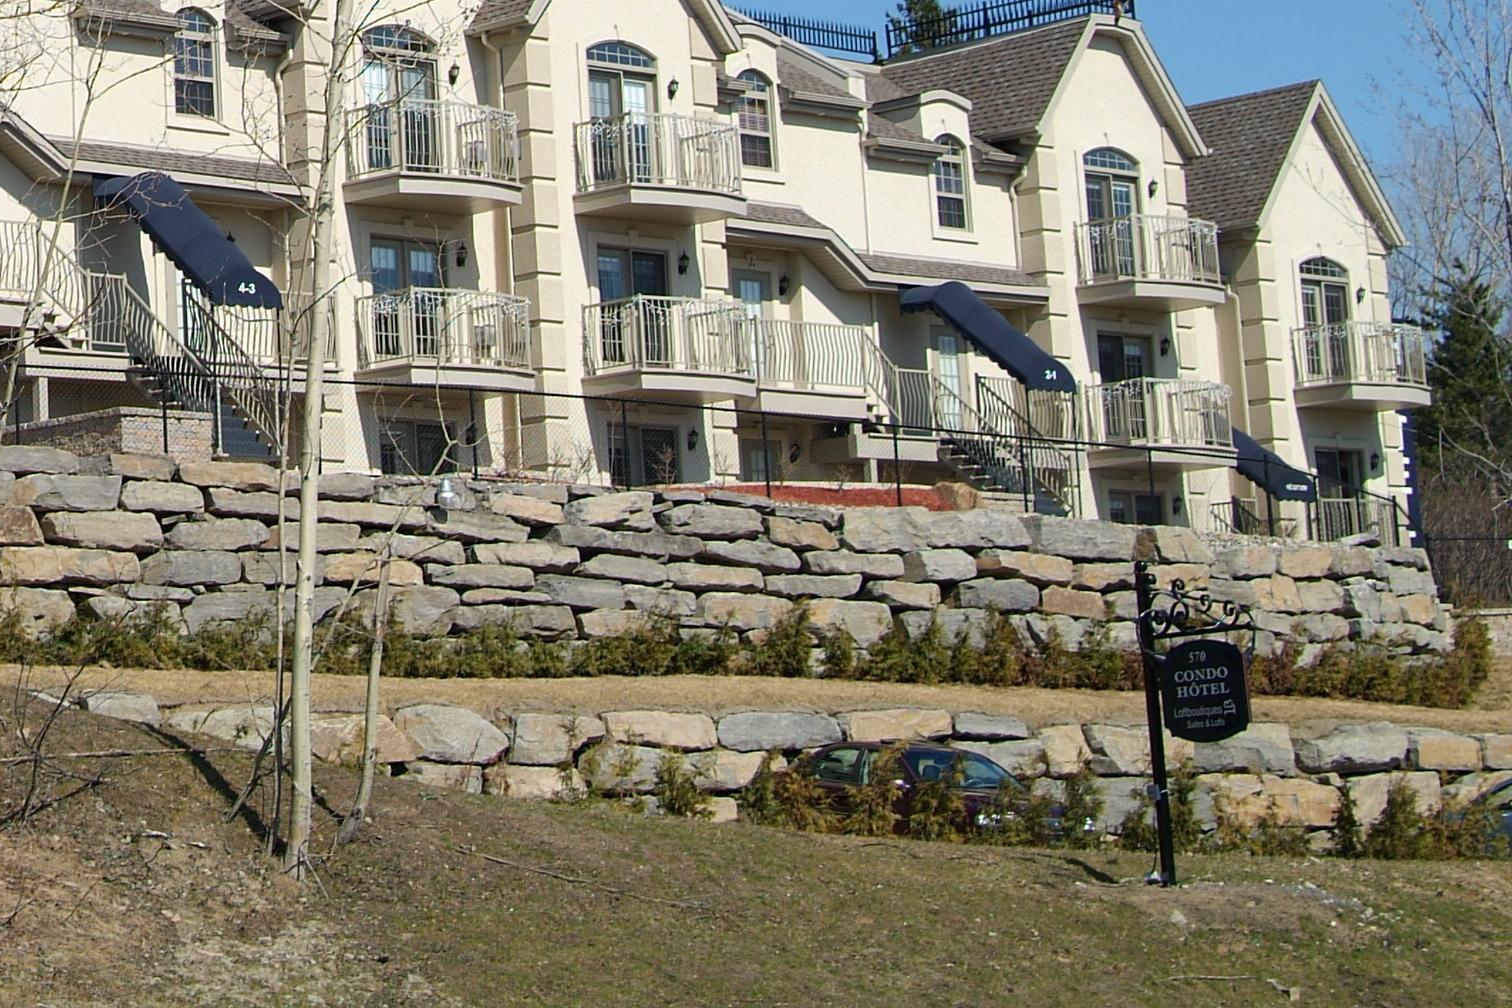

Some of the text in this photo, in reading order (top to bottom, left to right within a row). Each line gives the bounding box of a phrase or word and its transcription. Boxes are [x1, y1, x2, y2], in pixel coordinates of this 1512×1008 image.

[238, 281, 256, 295] 4-3
[1188, 650, 1206, 663] 570
[1174, 666, 1228, 682] CONDO
[1177, 682, 1230, 697] HÔTEL
